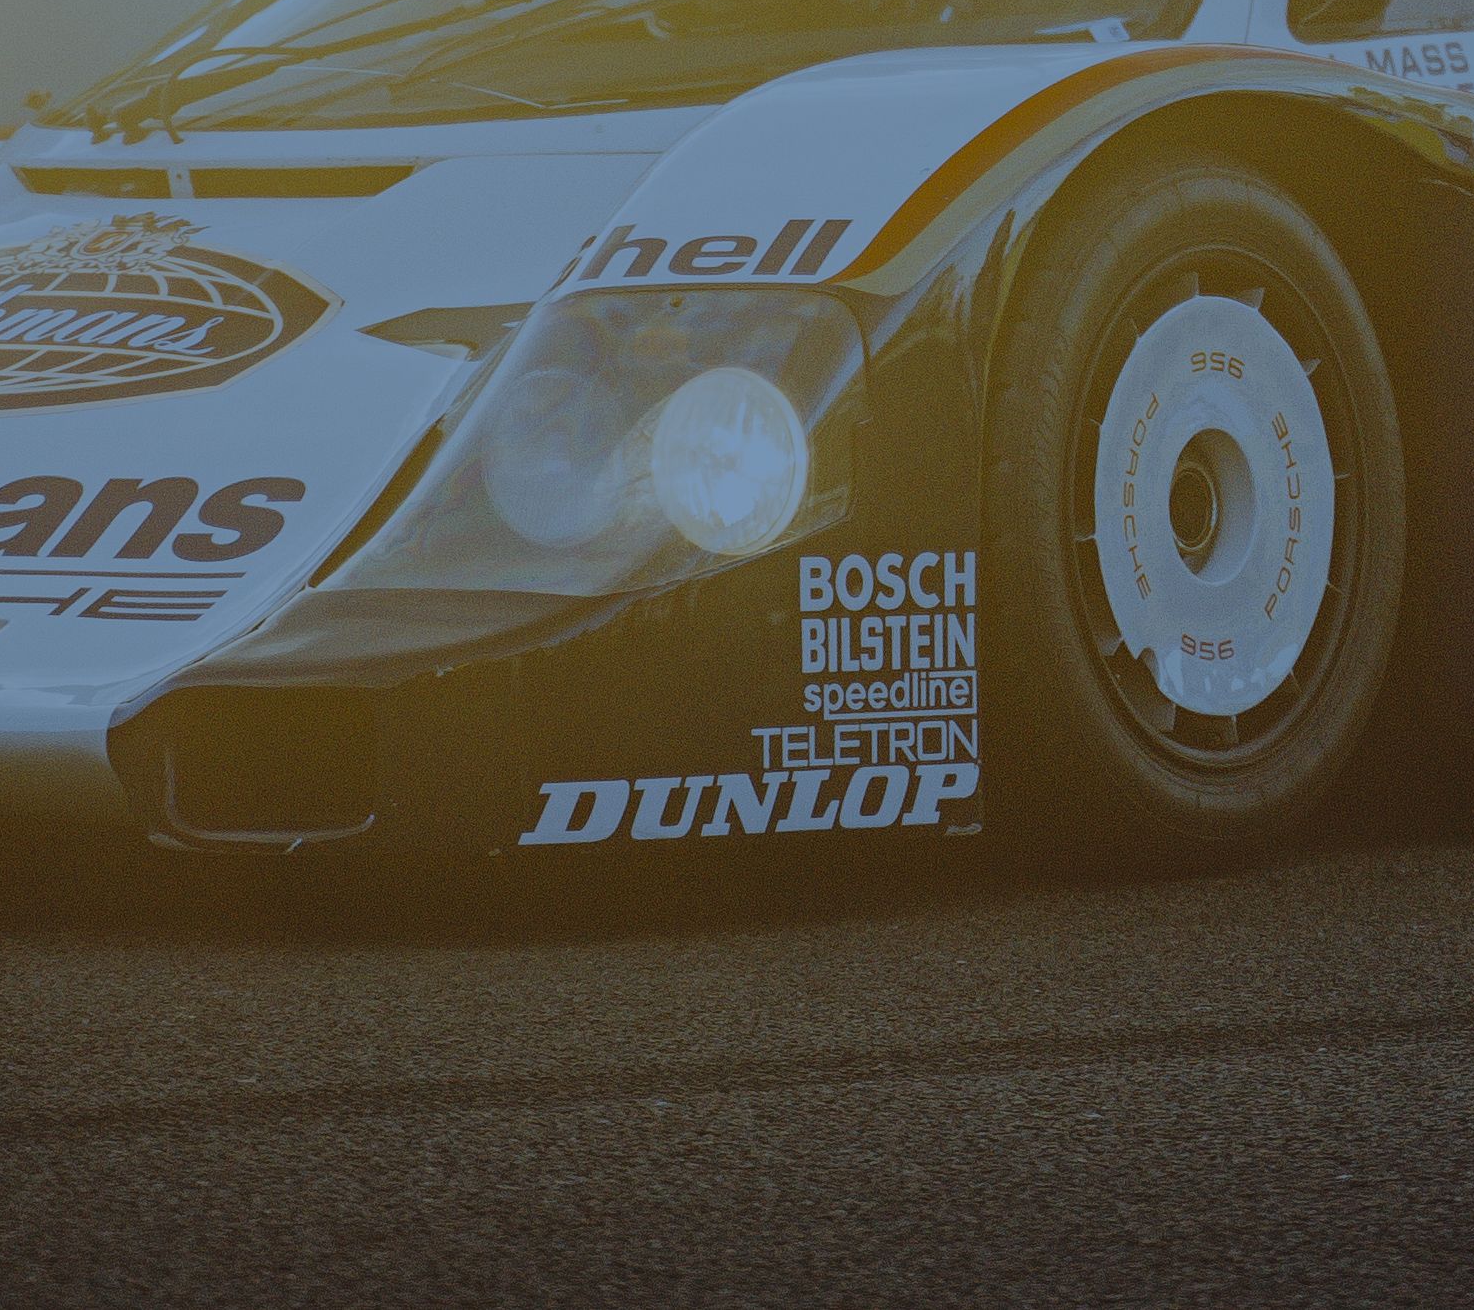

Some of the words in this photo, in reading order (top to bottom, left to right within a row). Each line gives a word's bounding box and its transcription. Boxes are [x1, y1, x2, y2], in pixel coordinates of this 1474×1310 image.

[1364, 40, 1471, 77] MASS
[1189, 350, 1246, 381] 956
[1123, 392, 1161, 601] PORSCHE
[1263, 411, 1302, 620] PORSCHE
[799, 551, 978, 613] BOSCH
[801, 612, 977, 675] BILSTEIN
[1180, 633, 1236, 661] 956
[803, 672, 971, 717] speedline
[750, 718, 980, 770] TELETRON
[517, 762, 981, 846] DUNLOP
